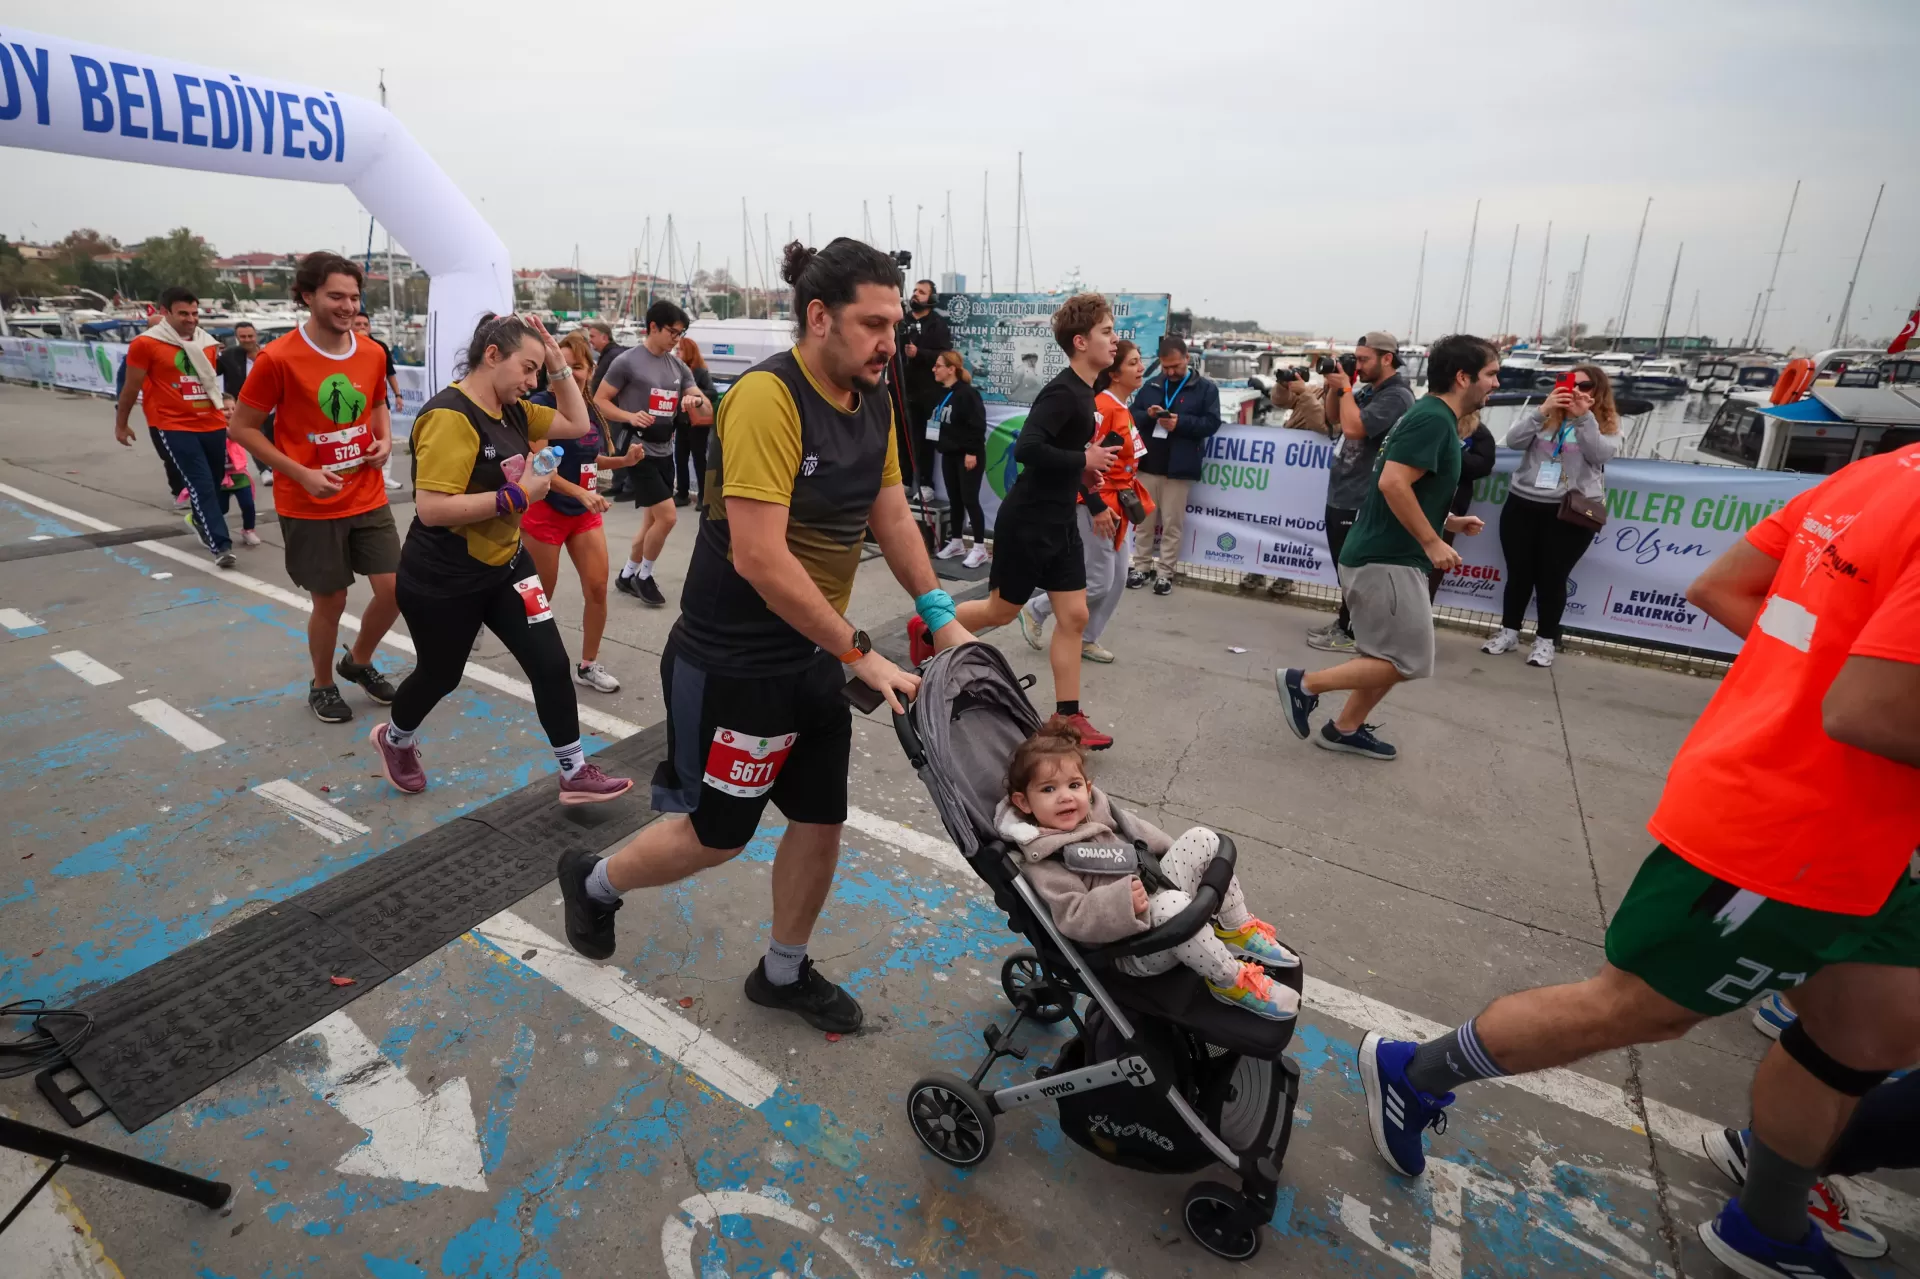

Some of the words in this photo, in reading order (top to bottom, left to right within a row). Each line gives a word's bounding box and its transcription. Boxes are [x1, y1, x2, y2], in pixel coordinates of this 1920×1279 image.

[70, 54, 345, 163] BELEDİYESİ
[989, 300, 1023, 317] YEŞİLKÖY
[1025, 303, 1035, 315] SU
[334, 443, 361, 461] 5726
[1603, 487, 1687, 525] NLER
[1206, 506, 1283, 527] HİZMETLERİ
[1273, 541, 1314, 557] EVİMİZ
[1616, 526, 1711, 565] Olsun
[1263, 553, 1322, 571] BAKIRKÖY
[1629, 589, 1688, 609] EVİMİZ
[1612, 602, 1698, 625] BAKIRKÖY
[559, 757, 574, 772] S
[729, 760, 774, 783] 5671
[1077, 847, 1114, 859] YOYKO
[1040, 1081, 1075, 1097] YOYKO
[1109, 1121, 1175, 1152] YOYKO
